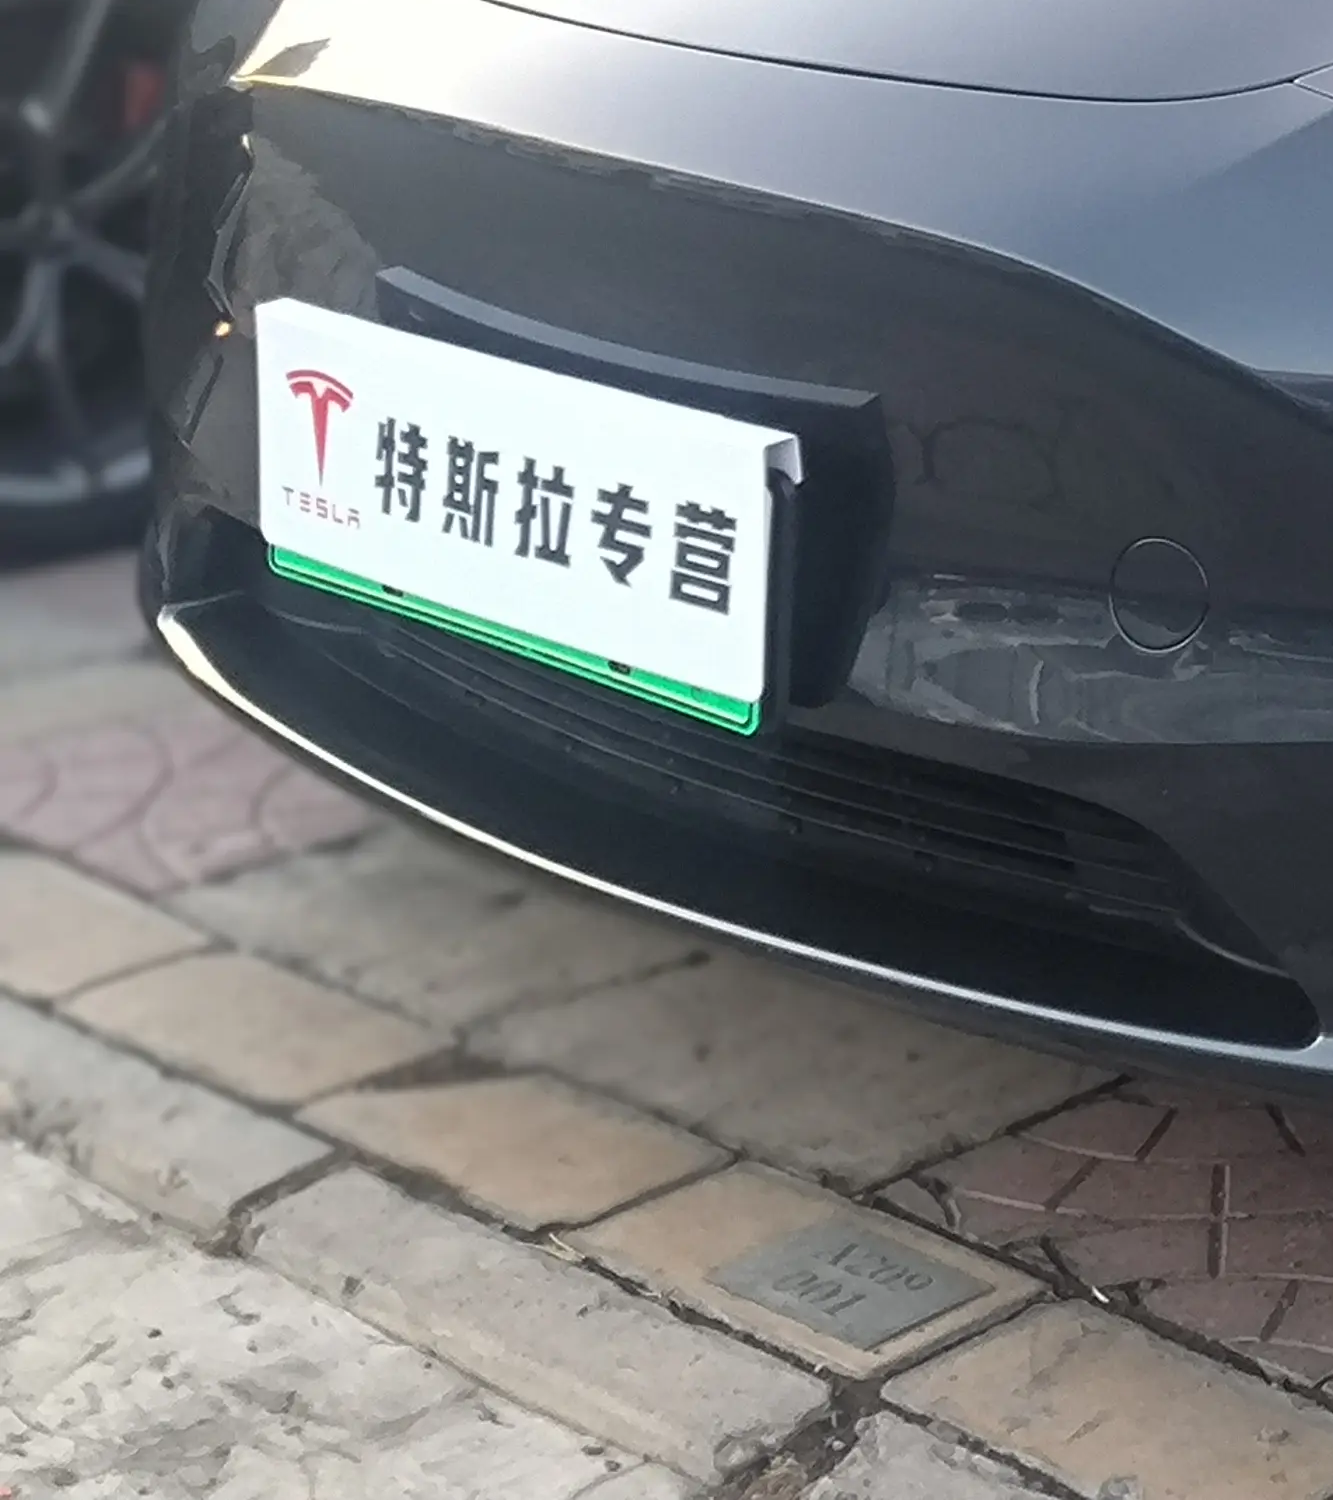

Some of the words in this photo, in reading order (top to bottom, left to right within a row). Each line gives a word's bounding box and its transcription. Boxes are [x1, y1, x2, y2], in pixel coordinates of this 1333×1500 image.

[282, 485, 360, 530] TESLA
[374, 417, 738, 615] 特斯拉专营
